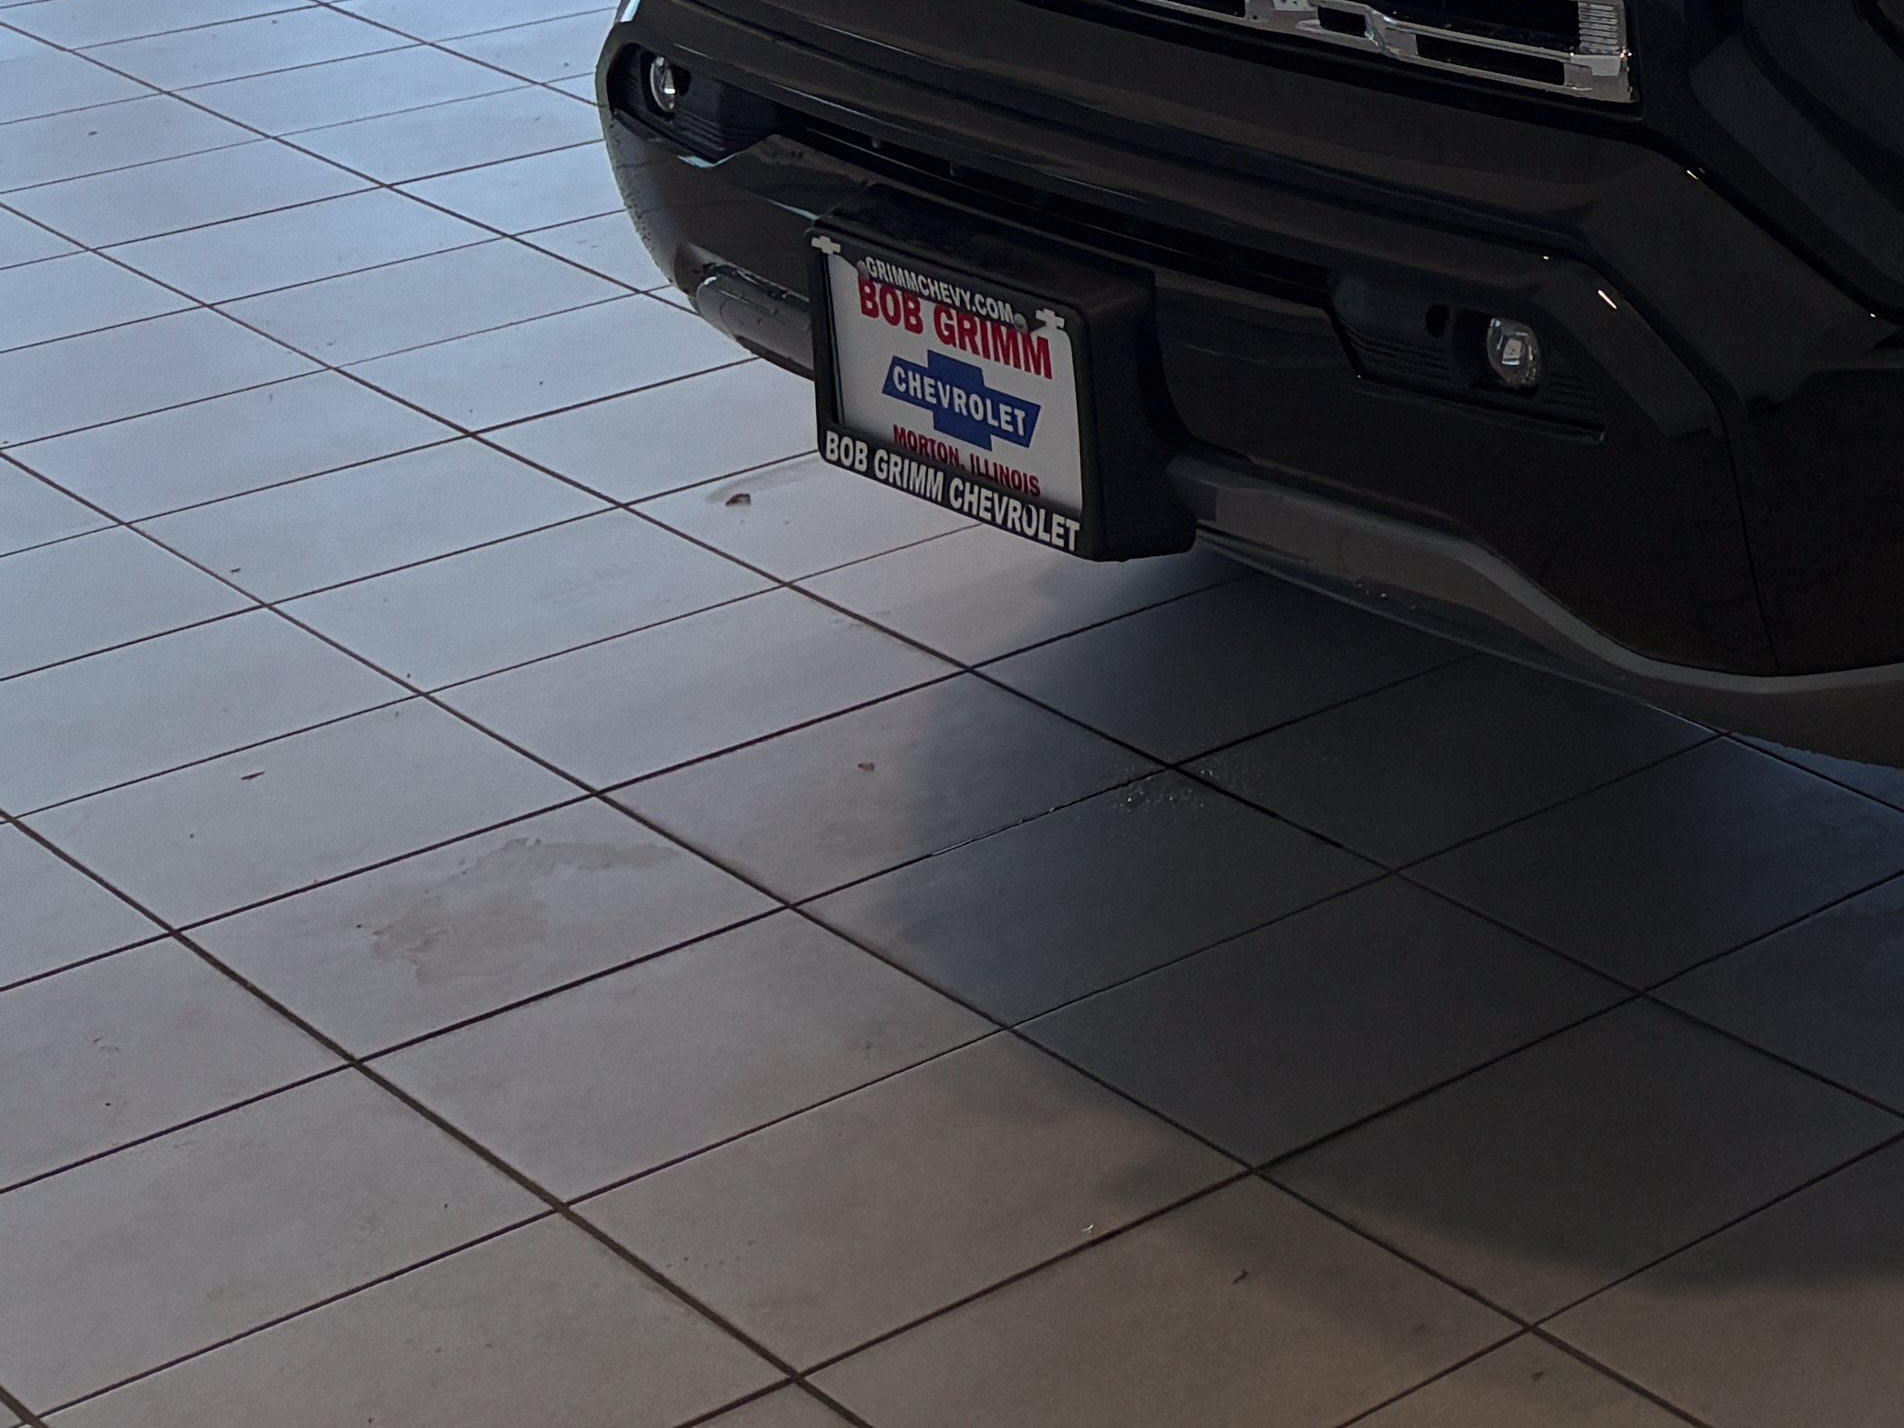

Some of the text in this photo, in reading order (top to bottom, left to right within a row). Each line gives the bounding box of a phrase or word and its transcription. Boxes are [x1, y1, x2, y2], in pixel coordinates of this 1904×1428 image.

[865, 256, 1016, 325] GRIMMCHEVY.COM
[857, 276, 1053, 380] BOB GRIMM
[892, 364, 1027, 437] CHEVROLET
[825, 430, 1081, 553] BOB GRIMM CHEVROLET
[969, 452, 1042, 498] ILLINOIS
